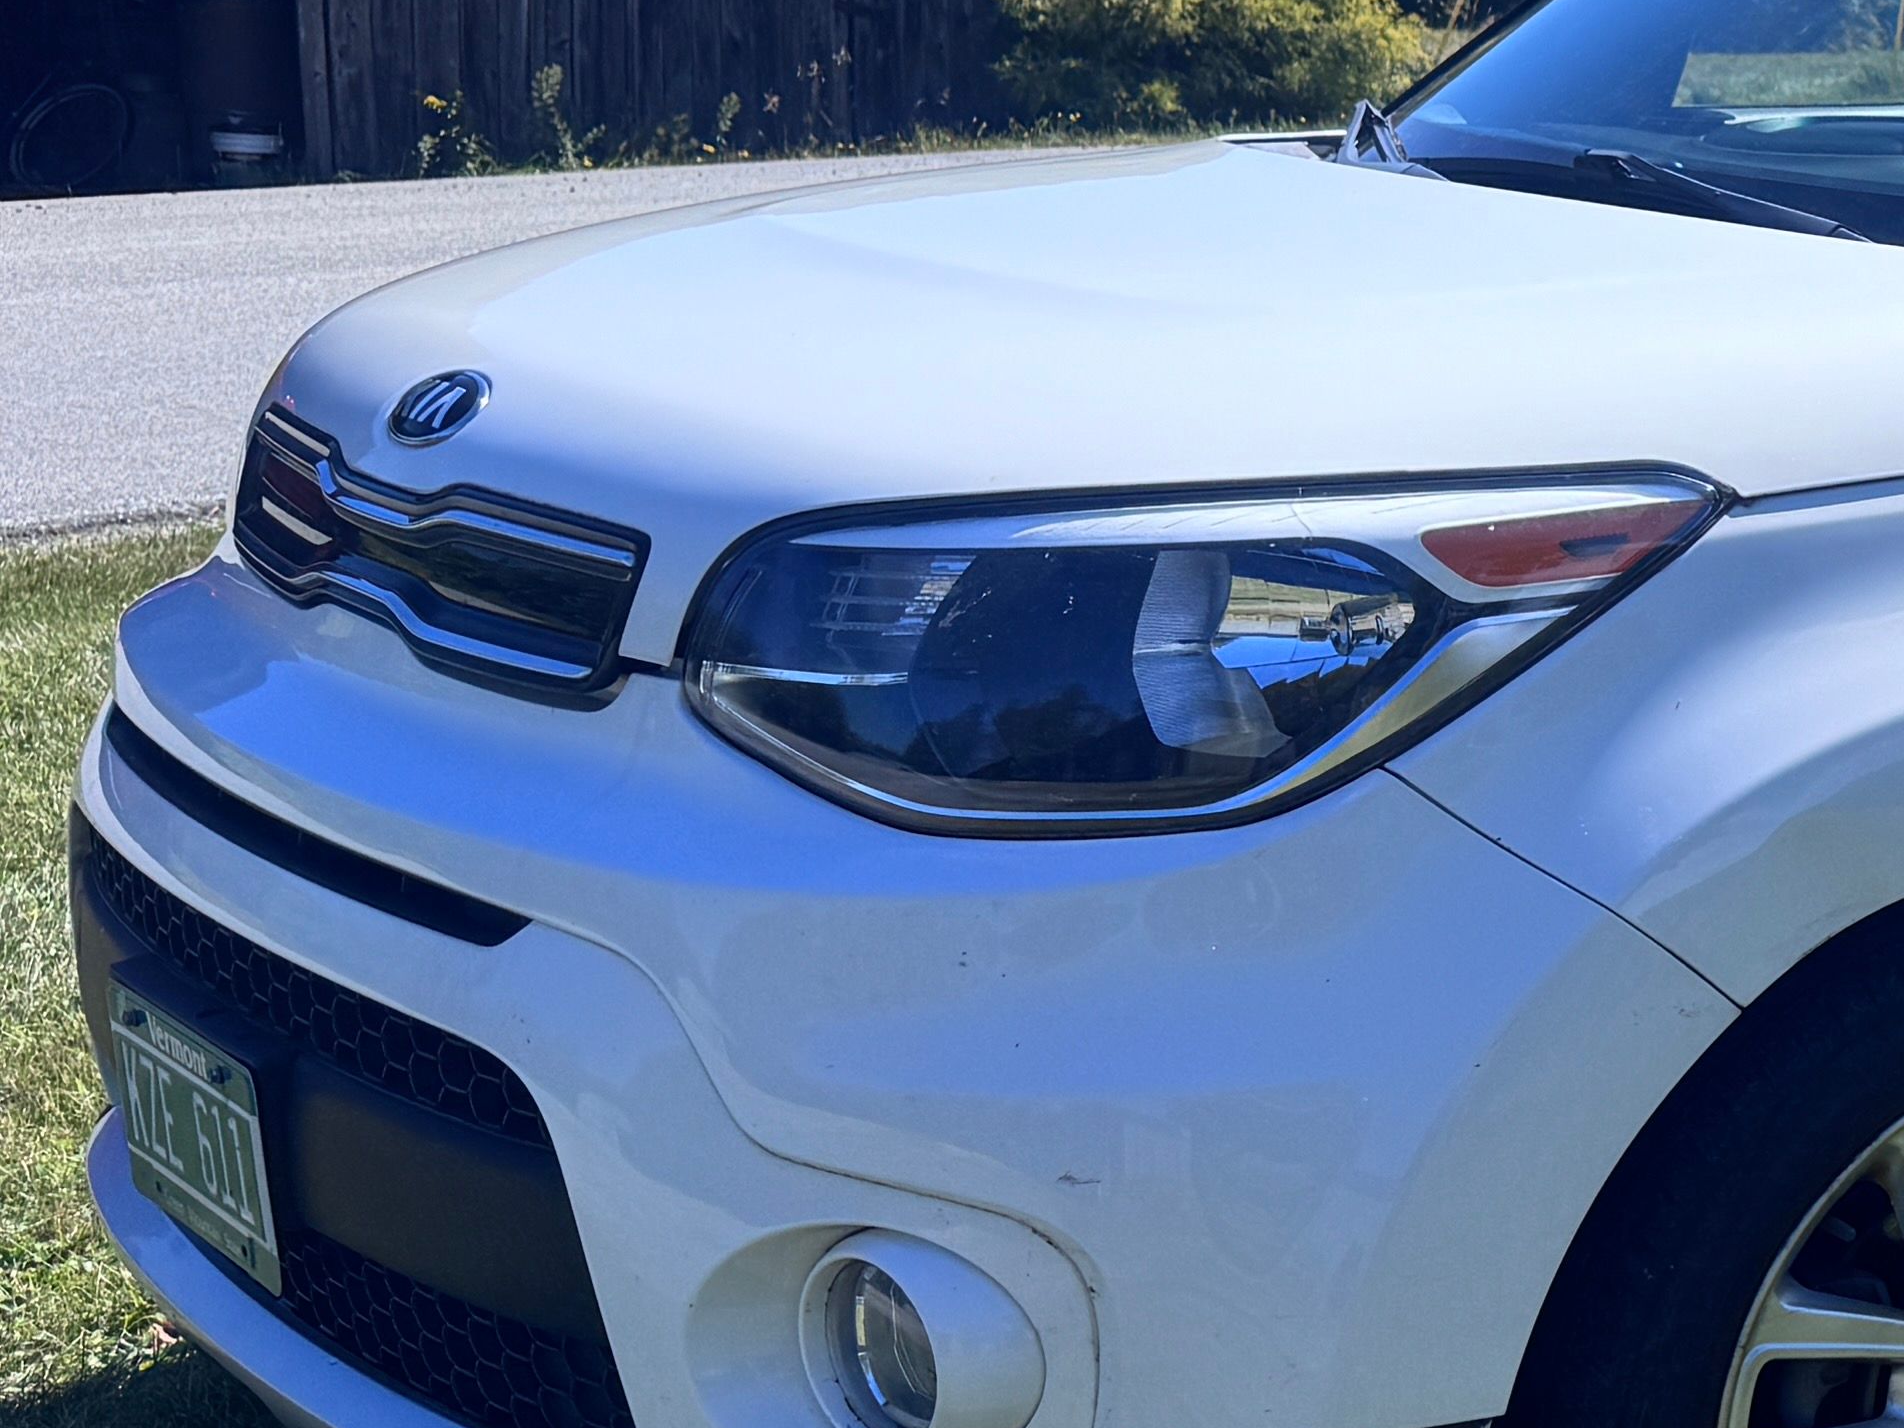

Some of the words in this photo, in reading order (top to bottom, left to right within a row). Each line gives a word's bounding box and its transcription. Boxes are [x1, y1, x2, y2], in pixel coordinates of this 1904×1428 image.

[146, 1010, 208, 1079] Vermont
[121, 1041, 184, 1172] KZE
[193, 1091, 255, 1226] 611
